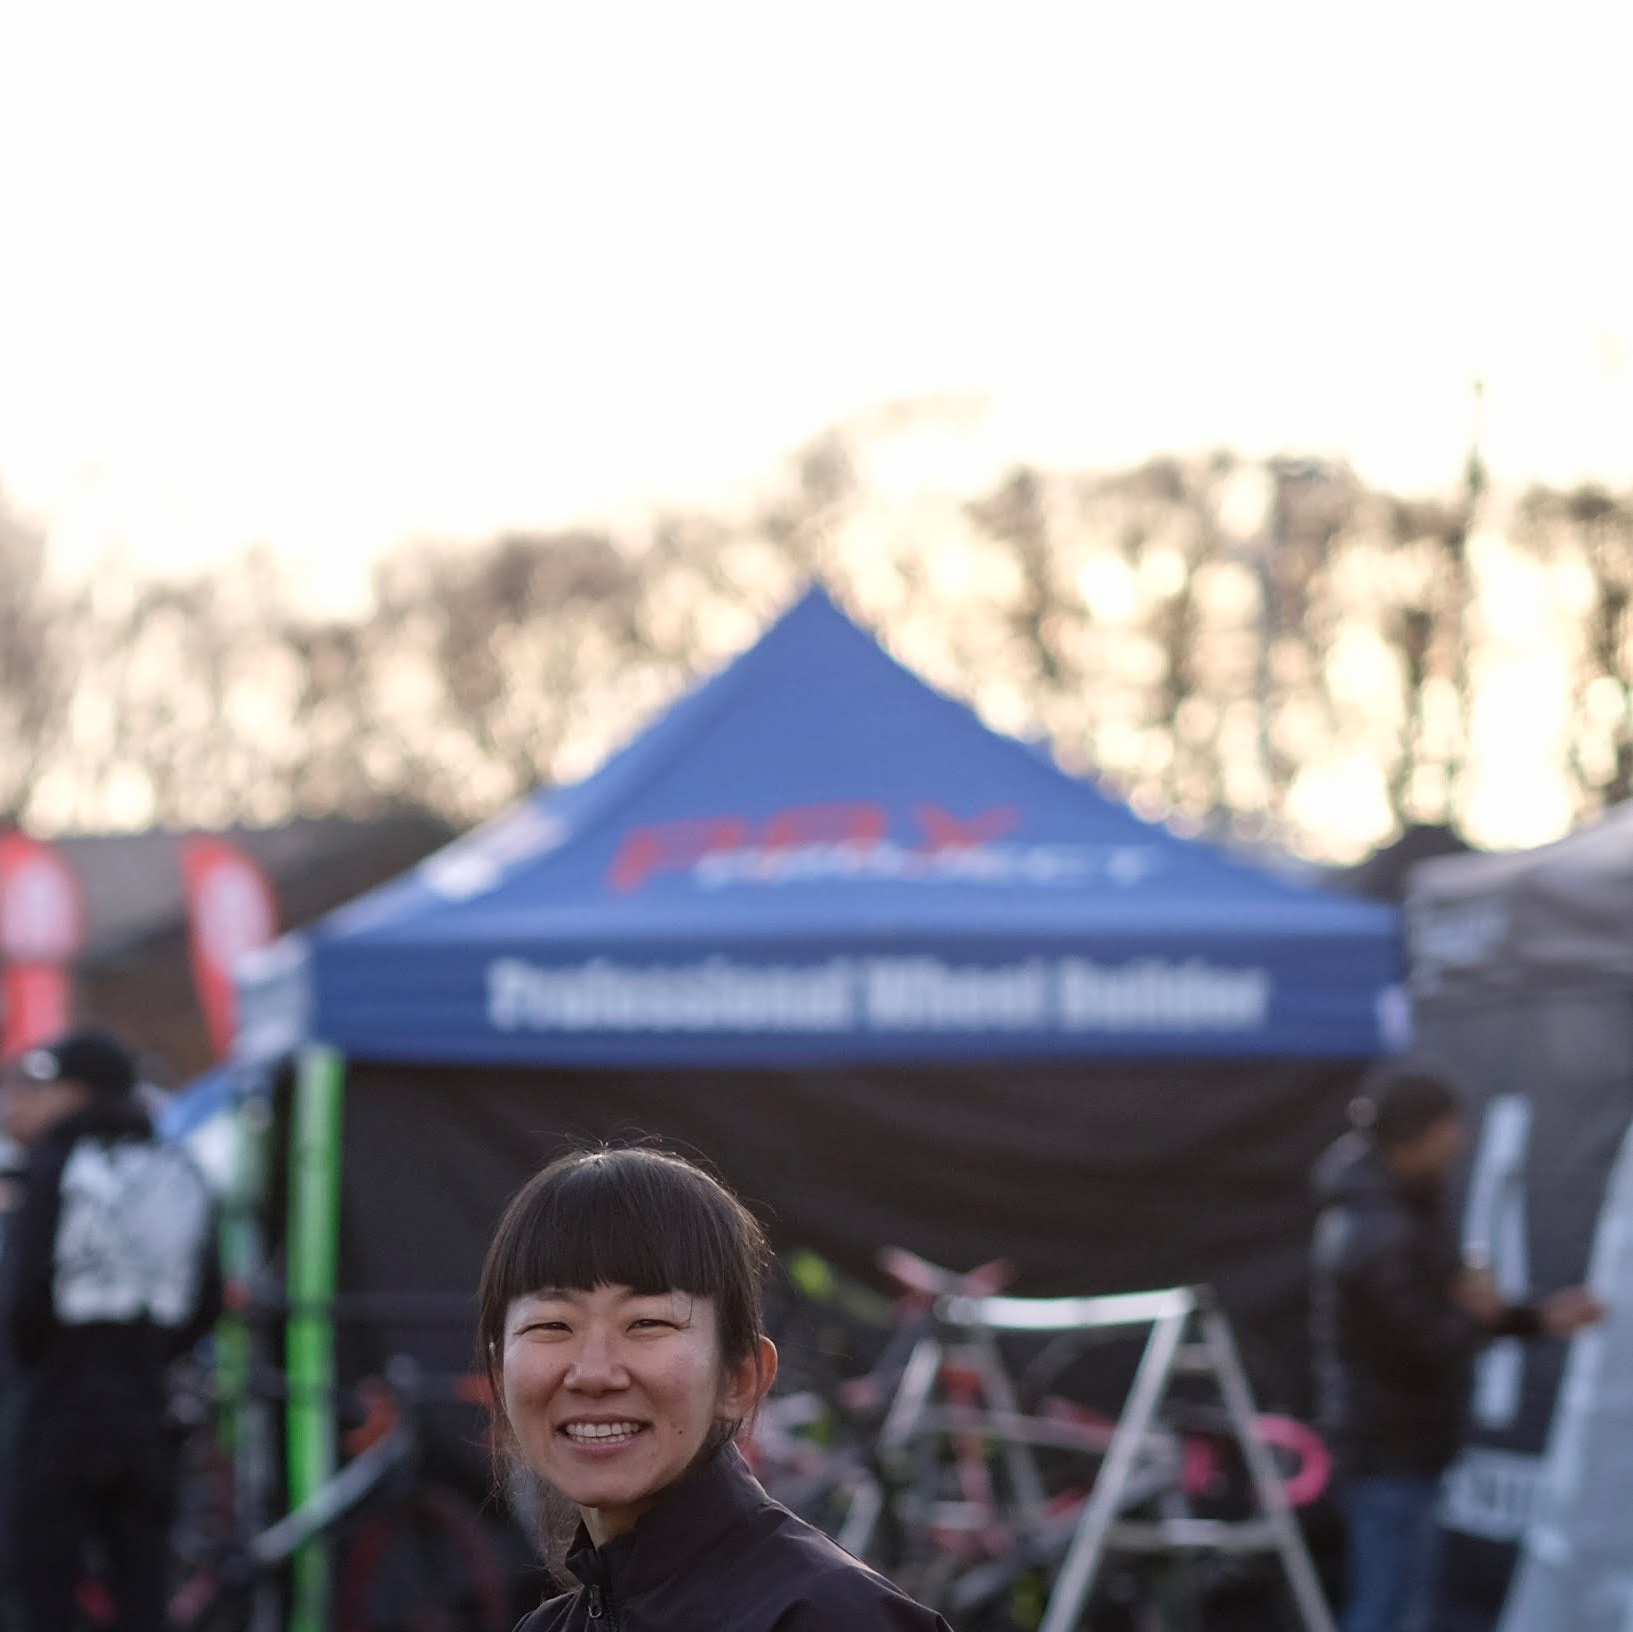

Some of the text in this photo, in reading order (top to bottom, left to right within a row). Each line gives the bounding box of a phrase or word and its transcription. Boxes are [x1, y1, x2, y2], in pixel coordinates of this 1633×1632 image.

[488, 956, 1269, 1032] Professional Wheel Builder
